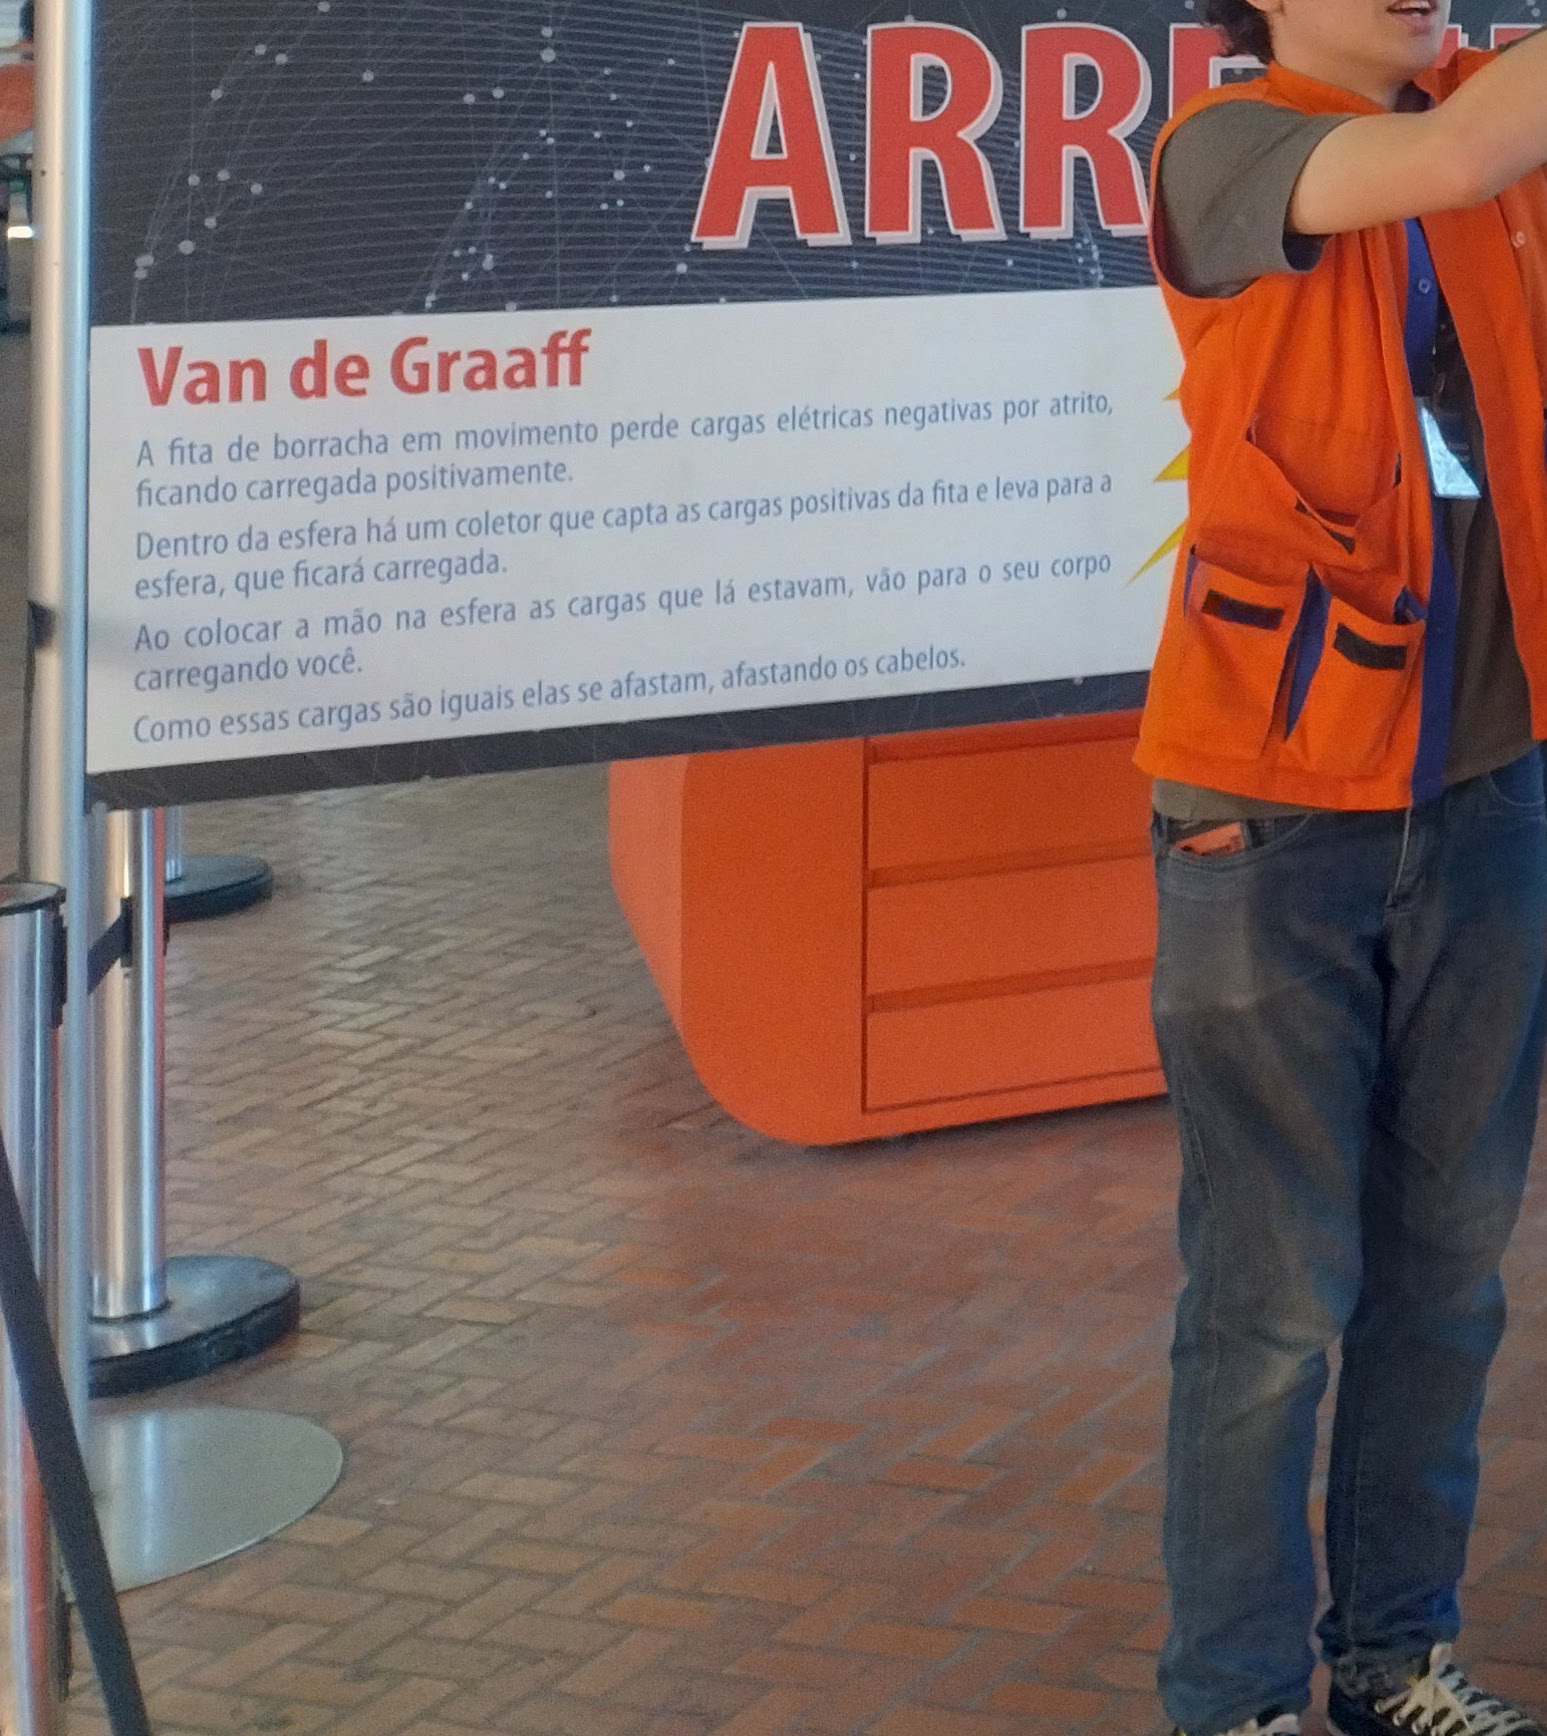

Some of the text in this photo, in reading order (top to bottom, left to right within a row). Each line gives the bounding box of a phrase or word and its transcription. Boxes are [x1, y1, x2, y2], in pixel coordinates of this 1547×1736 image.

[137, 327, 593, 407] Van de Graaff
[136, 391, 1113, 468] A fita de borracha em movimento perde cargas elétricas negativas por atrito,
[136, 461, 573, 507] ficando carregada positivamente.
[136, 474, 1112, 560] Dentro da esfera há um coletor que capta as cargas positivas da fita e leva para a
[134, 547, 507, 600] esfera, que ficará carregada.
[134, 554, 1111, 652] Ao colocar a mão na esfera as cargas que lá estavam, vão para o seu corpo
[133, 645, 965, 743] Como essas cargas são iguais elas se afastam, afastando os cabelos.
[134, 646, 362, 694] carregando você.
